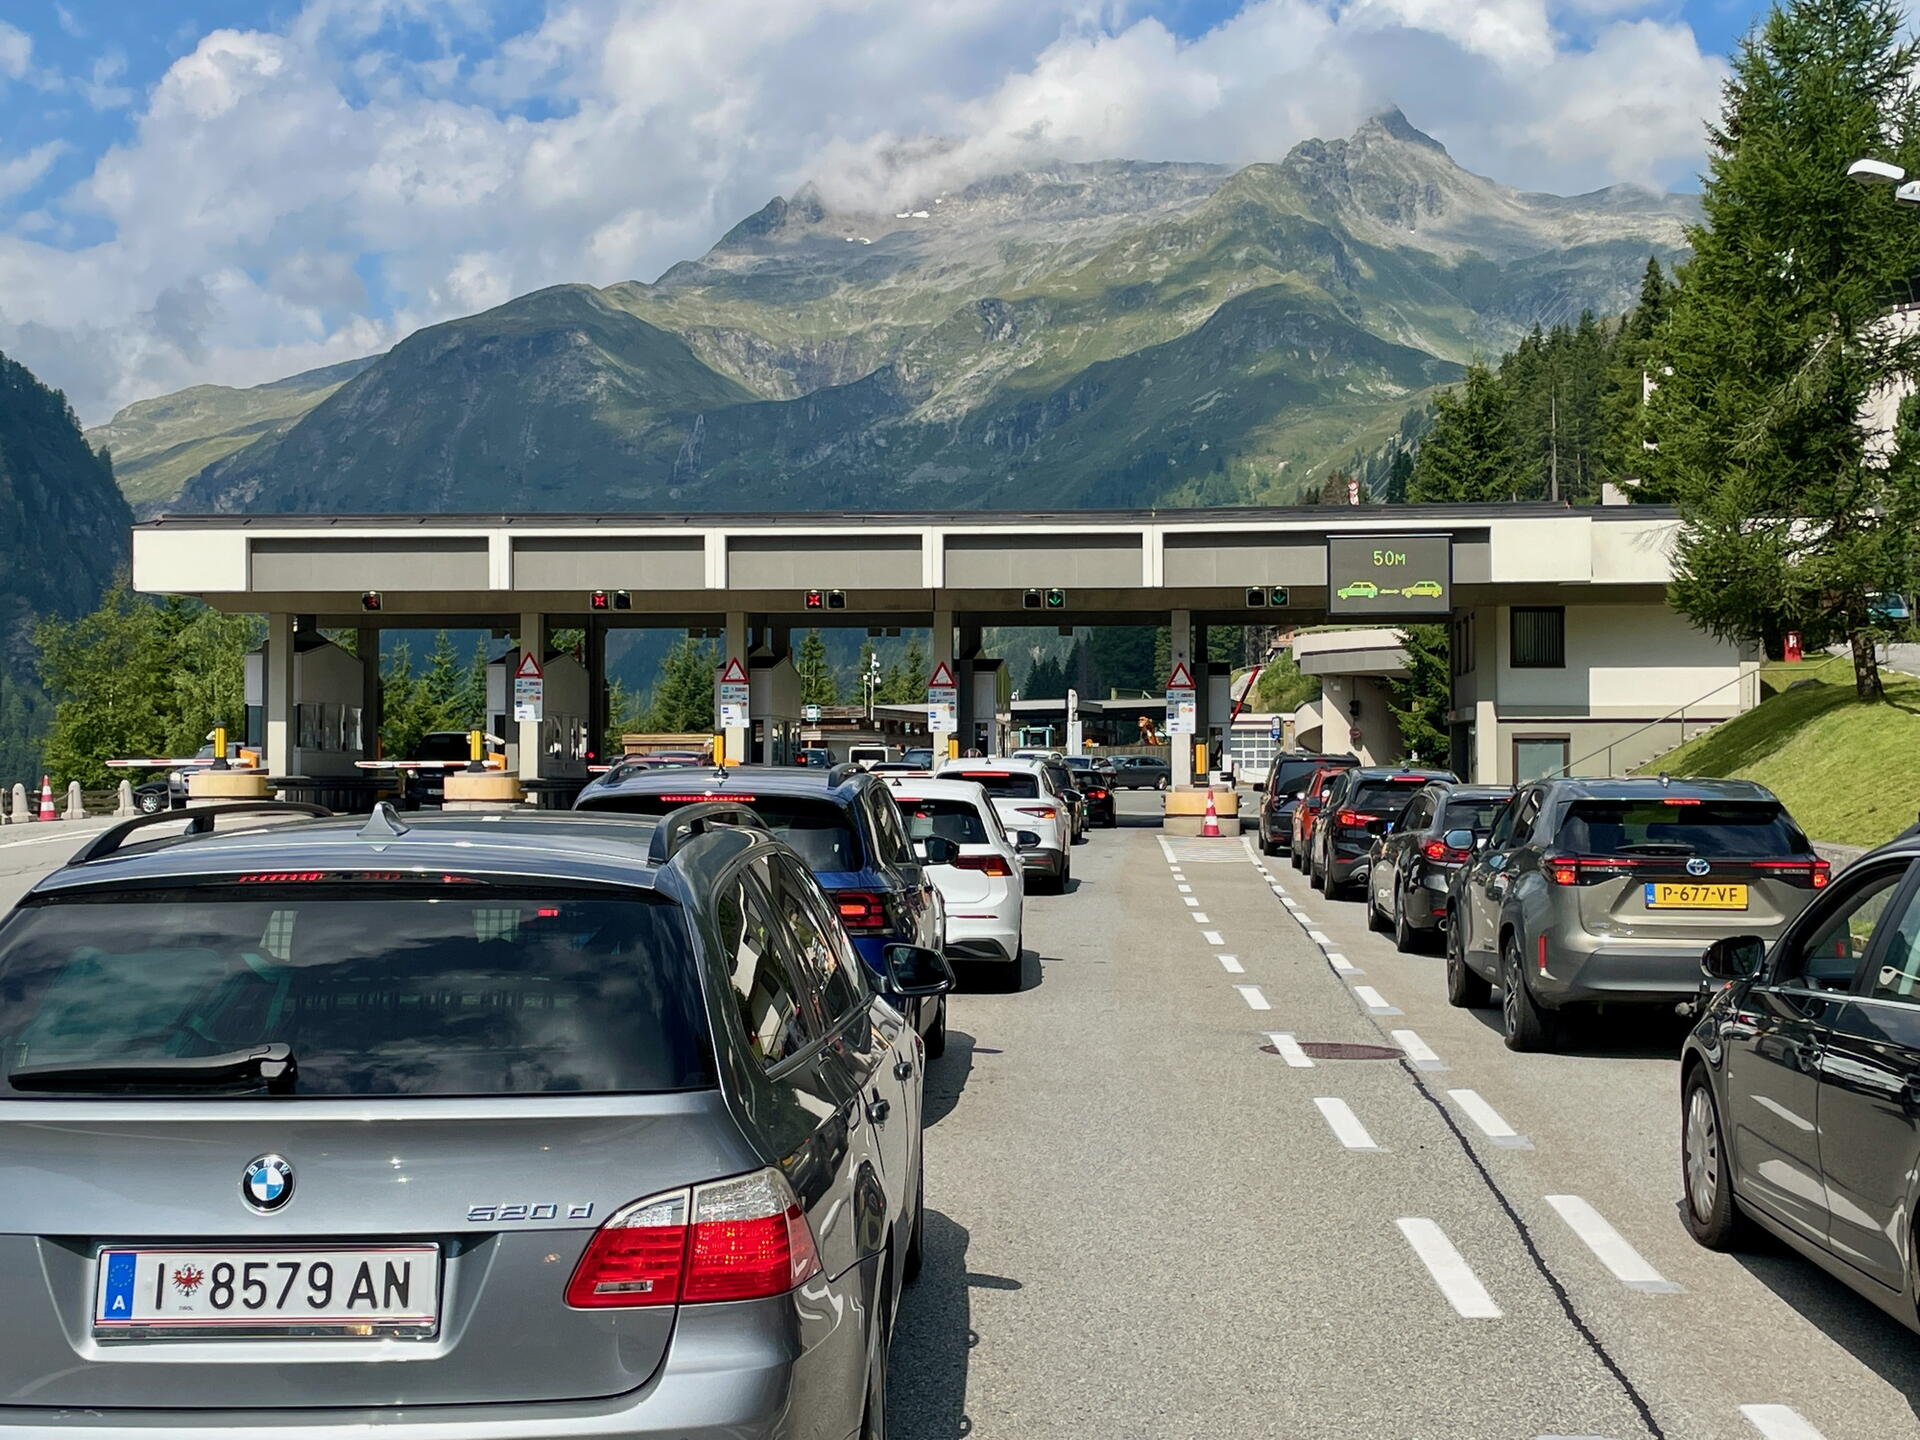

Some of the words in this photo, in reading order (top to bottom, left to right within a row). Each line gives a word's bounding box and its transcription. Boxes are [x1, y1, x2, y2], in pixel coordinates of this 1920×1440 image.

[1373, 550, 1406, 566] 50M
[1663, 886, 1737, 902] P-677-VF
[209, 1261, 334, 1310] 8579
[346, 1259, 411, 1309] AN
[112, 1294, 126, 1311] A
